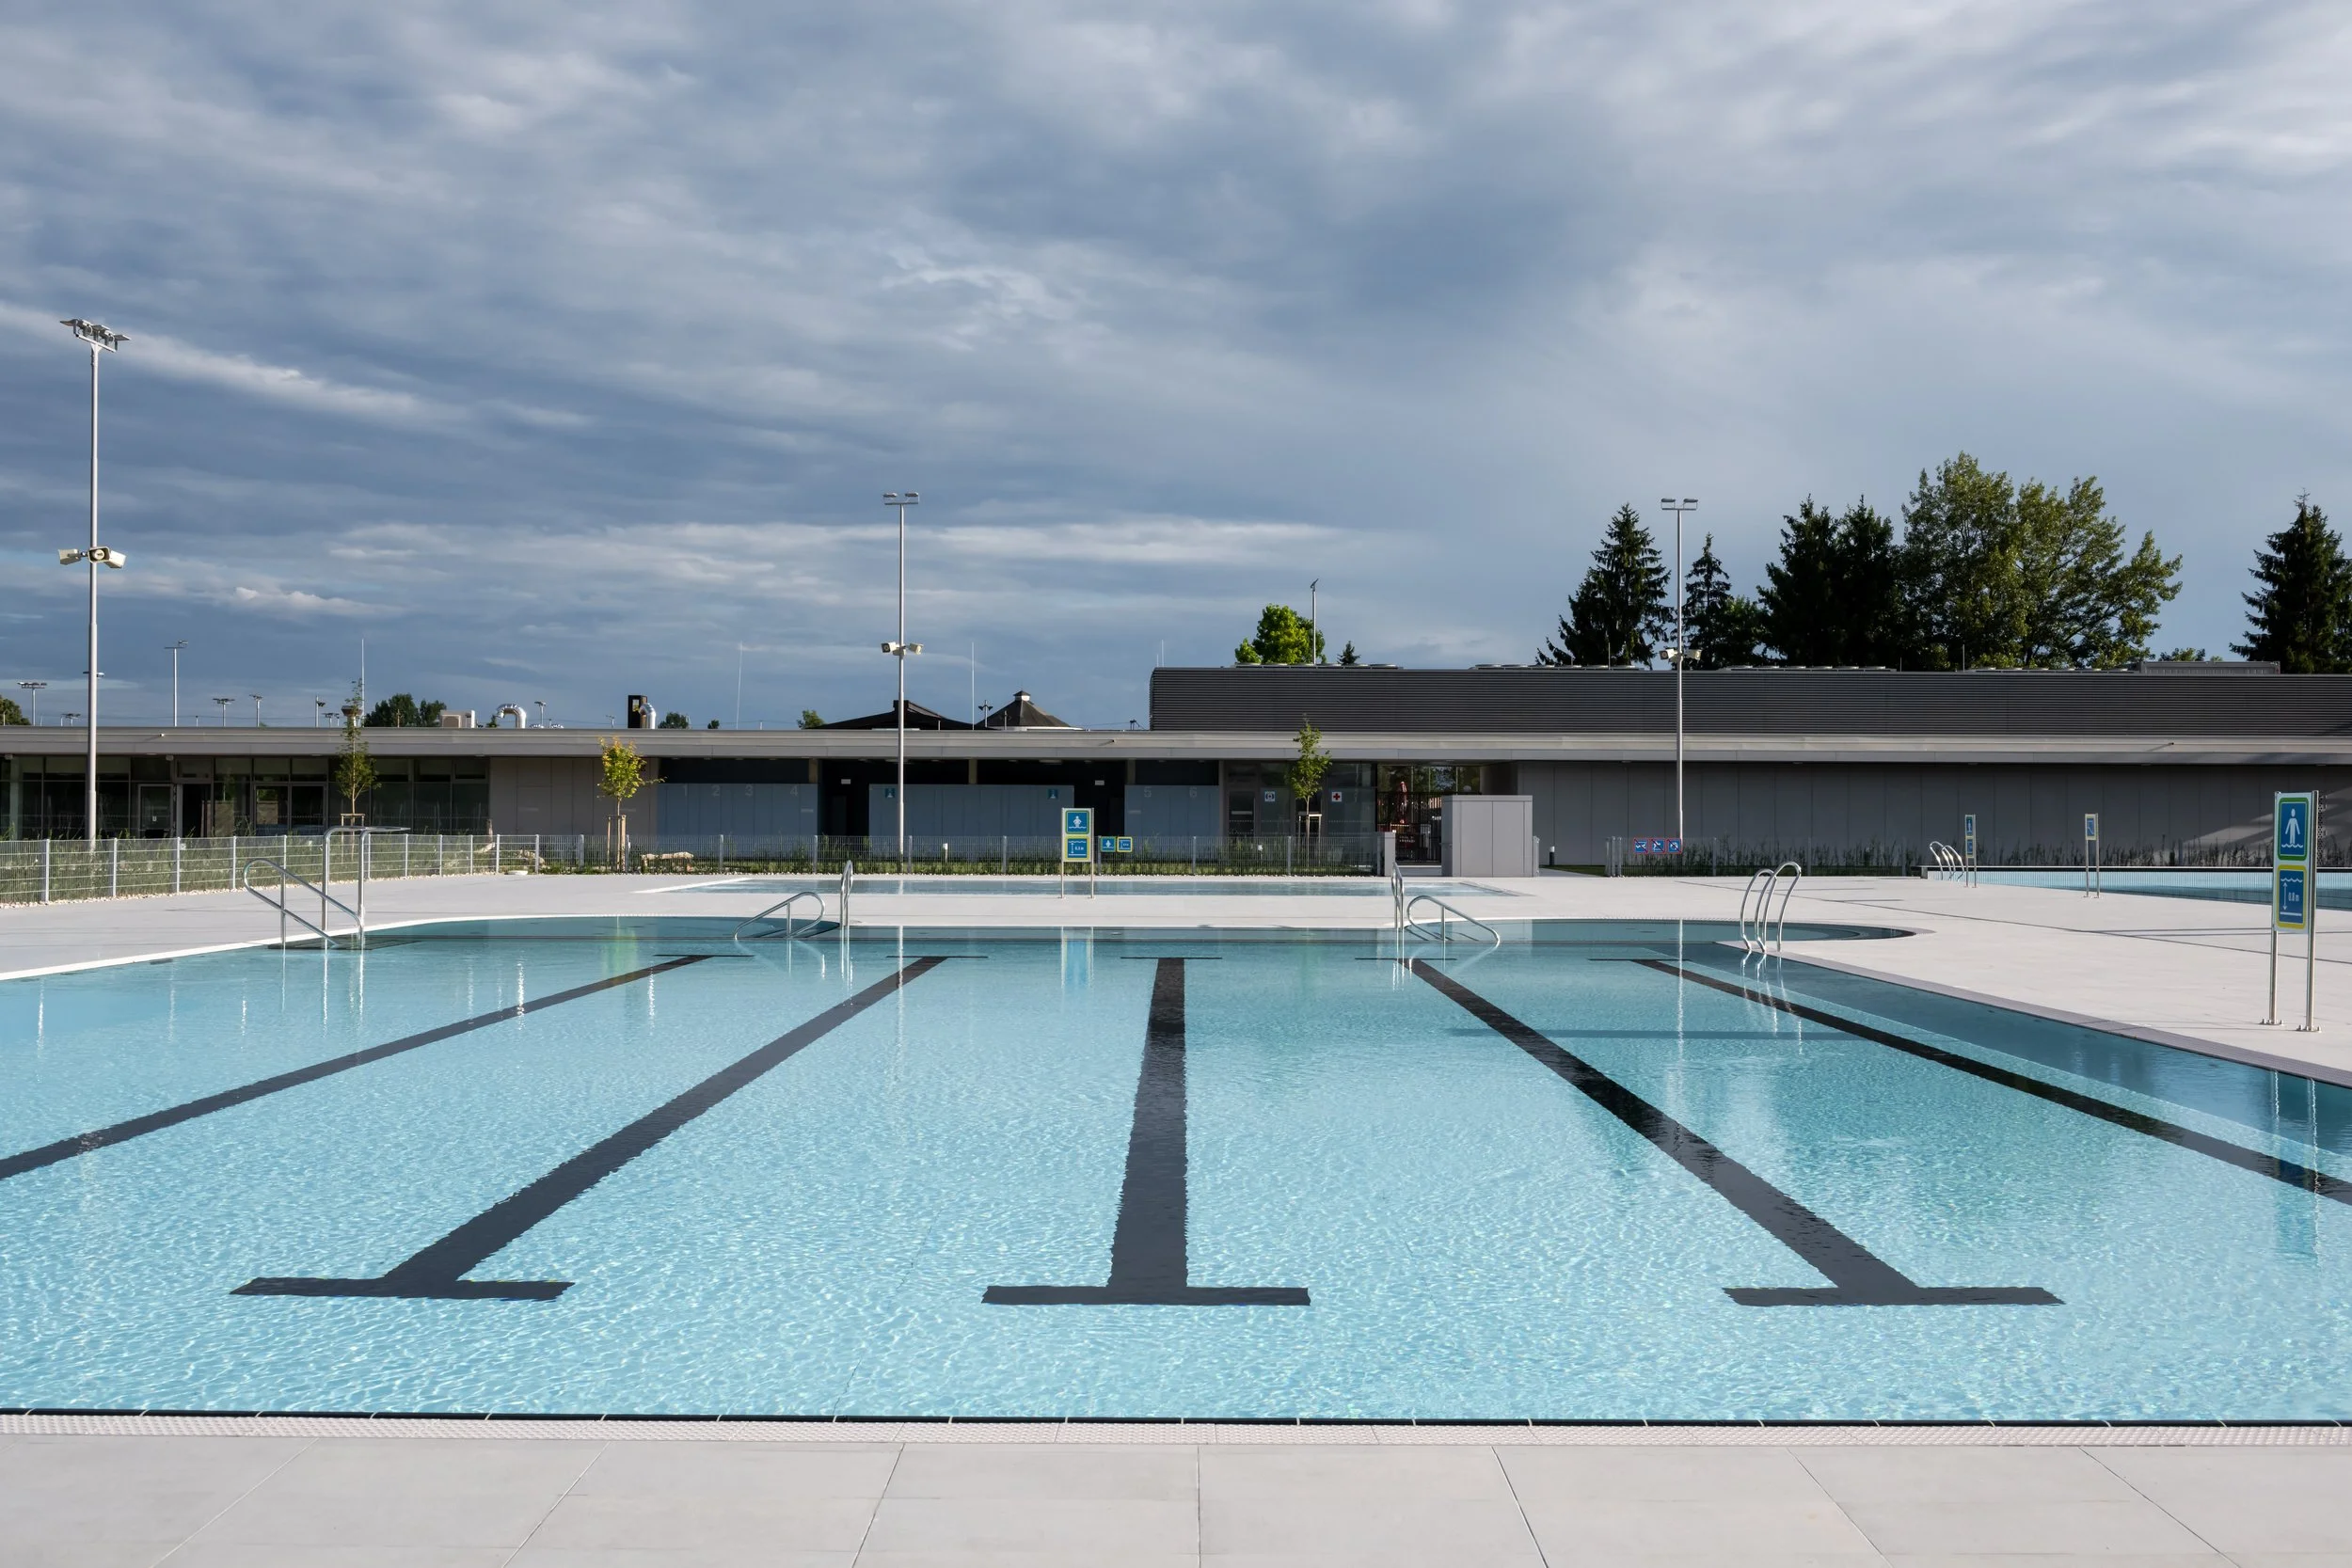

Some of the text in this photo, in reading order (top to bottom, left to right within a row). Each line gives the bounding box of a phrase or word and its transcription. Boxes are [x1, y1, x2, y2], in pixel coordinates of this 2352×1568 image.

[683, 784, 688, 797] 1
[711, 784, 721, 797] 2
[744, 784, 754, 797] 3
[789, 785, 799, 797] 4
[1143, 786, 1152, 798] 5
